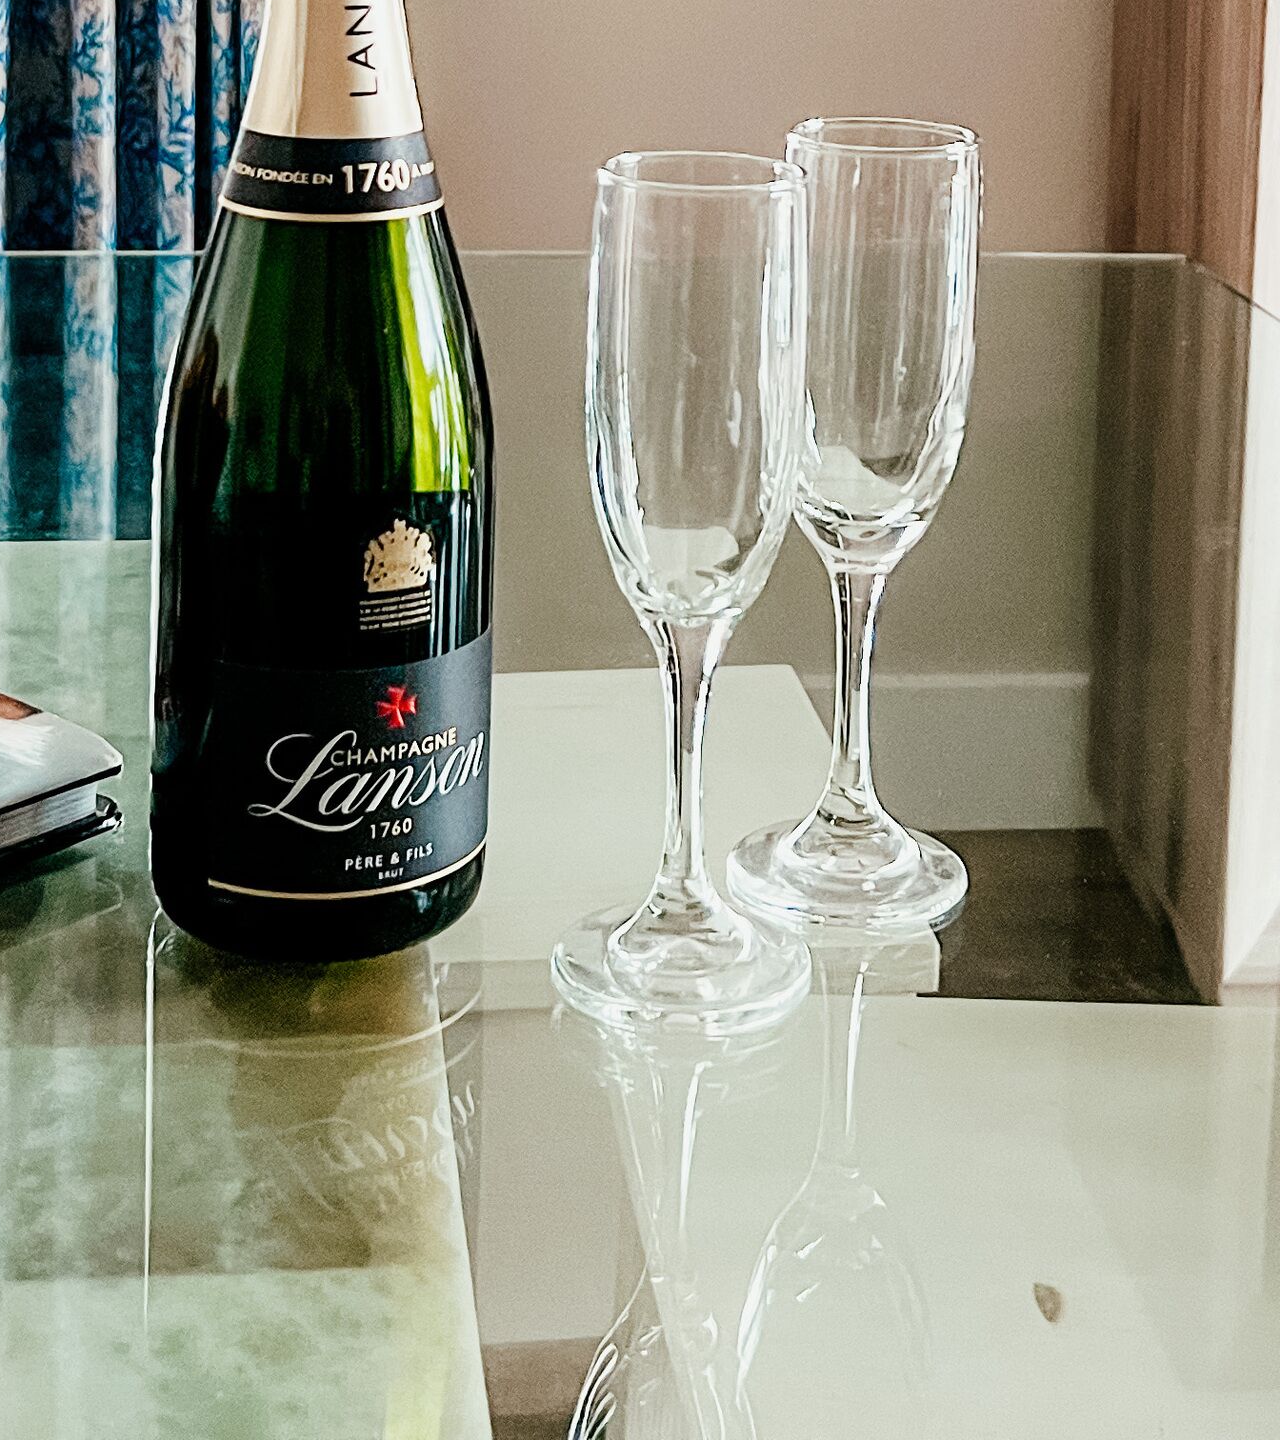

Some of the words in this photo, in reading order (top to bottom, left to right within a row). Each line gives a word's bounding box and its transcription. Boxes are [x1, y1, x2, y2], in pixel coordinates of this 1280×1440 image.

[312, 172, 334, 186] EN
[340, 158, 411, 194] 1760
[329, 727, 457, 768] CHAMPAGNE
[247, 729, 485, 833] Lanson
[369, 817, 413, 840] 1760
[344, 854, 384, 871] PÈRE
[389, 851, 400, 864] &
[406, 842, 433, 862] FILS
[378, 867, 404, 880] BRUT
